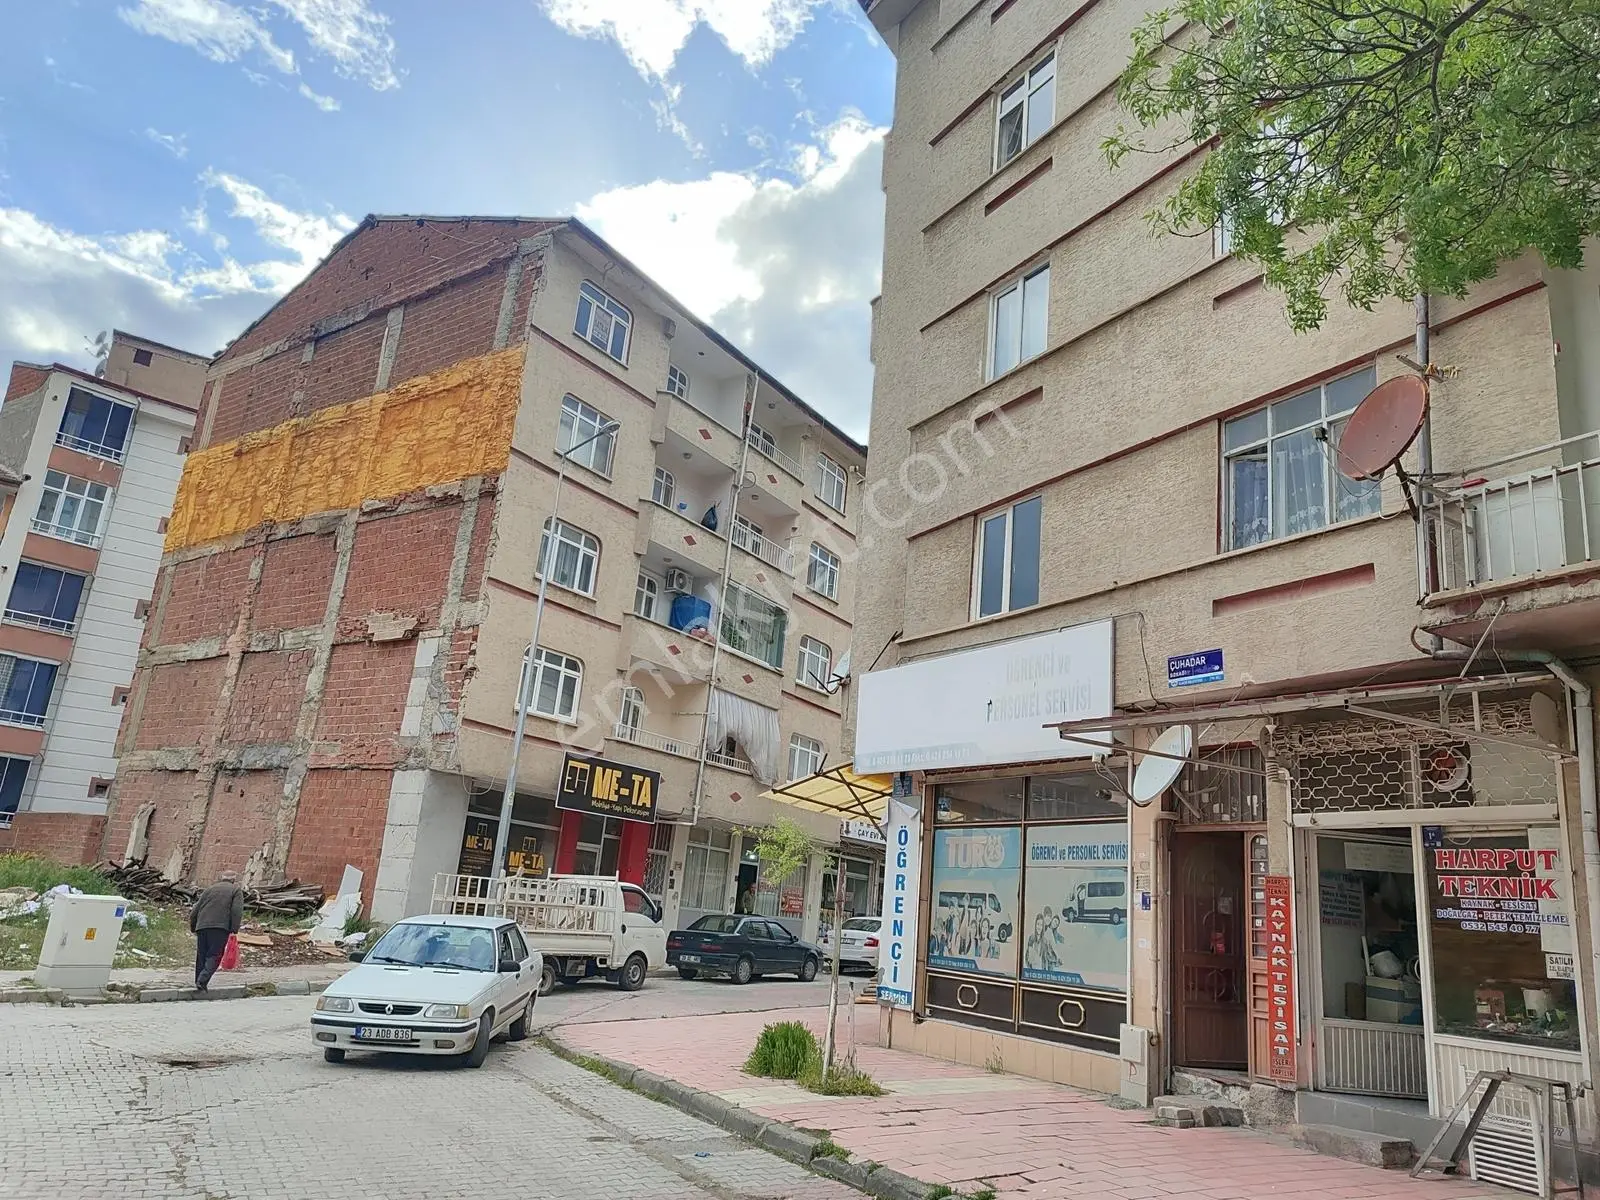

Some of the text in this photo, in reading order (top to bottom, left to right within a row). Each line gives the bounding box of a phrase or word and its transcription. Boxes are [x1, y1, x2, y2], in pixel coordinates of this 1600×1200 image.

[1170, 656, 1206, 671] ÇUHADAR
[591, 766, 651, 808] ME-TA
[465, 835, 493, 851] ME-TA
[508, 851, 544, 870] ME-TA
[1067, 845, 1100, 861] PERSONEL
[1434, 849, 1559, 871] HARPUT
[1438, 871, 1560, 900] TEKNİK
[891, 825, 908, 983] ÖĞRENCİ
[1461, 899, 1538, 911] KAYNAK TESİSAT
[1437, 908, 1568, 924] DOĞALGAZ PETEK TEMİZLEME
[1270, 898, 1288, 967] KAYNAK
[1461, 921, 1540, 934] 0532 545 40 77
[1273, 971, 1289, 1055] TESİSAT
[361, 1028, 372, 1038] 23
[394, 1030, 410, 1039] 836
